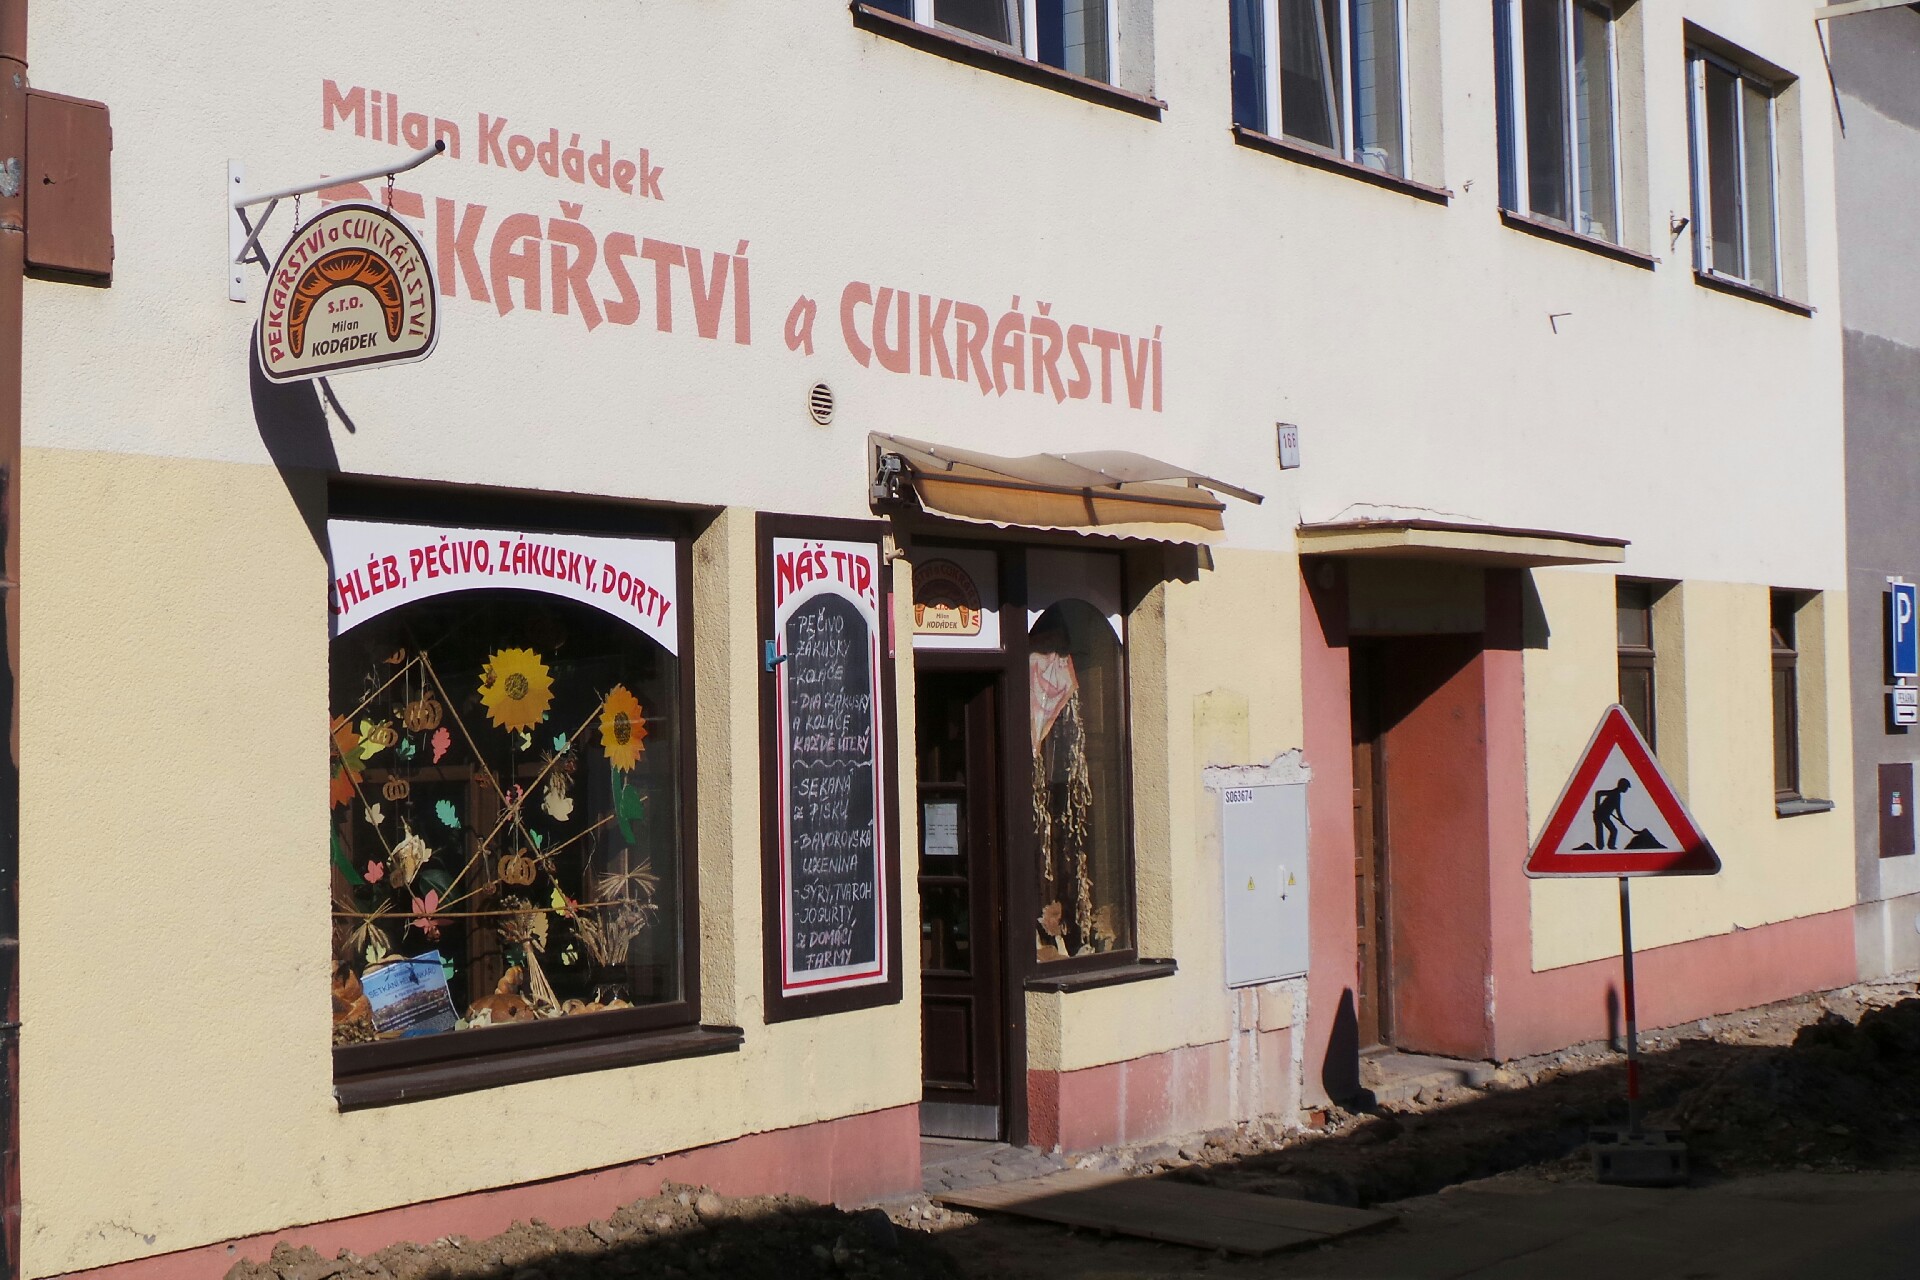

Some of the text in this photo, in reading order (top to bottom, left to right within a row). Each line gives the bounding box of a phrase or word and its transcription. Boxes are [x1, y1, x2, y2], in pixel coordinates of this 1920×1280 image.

[322, 78, 665, 201] Milan Kodádek
[268, 218, 428, 364] PEKAŘSTVÍ a CUKRÁŘSTVÍ
[317, 174, 1164, 413] KAŘSTVÍ a CUKRÁŘSTVÍ
[327, 296, 364, 314] s.r.o.
[331, 320, 359, 334] Milan
[328, 534, 671, 628] CHLÉB, PEČIVO, ZÁKUSKY, DORTY
[776, 542, 829, 609] NÁŠ
[1896, 592, 1912, 643] P
